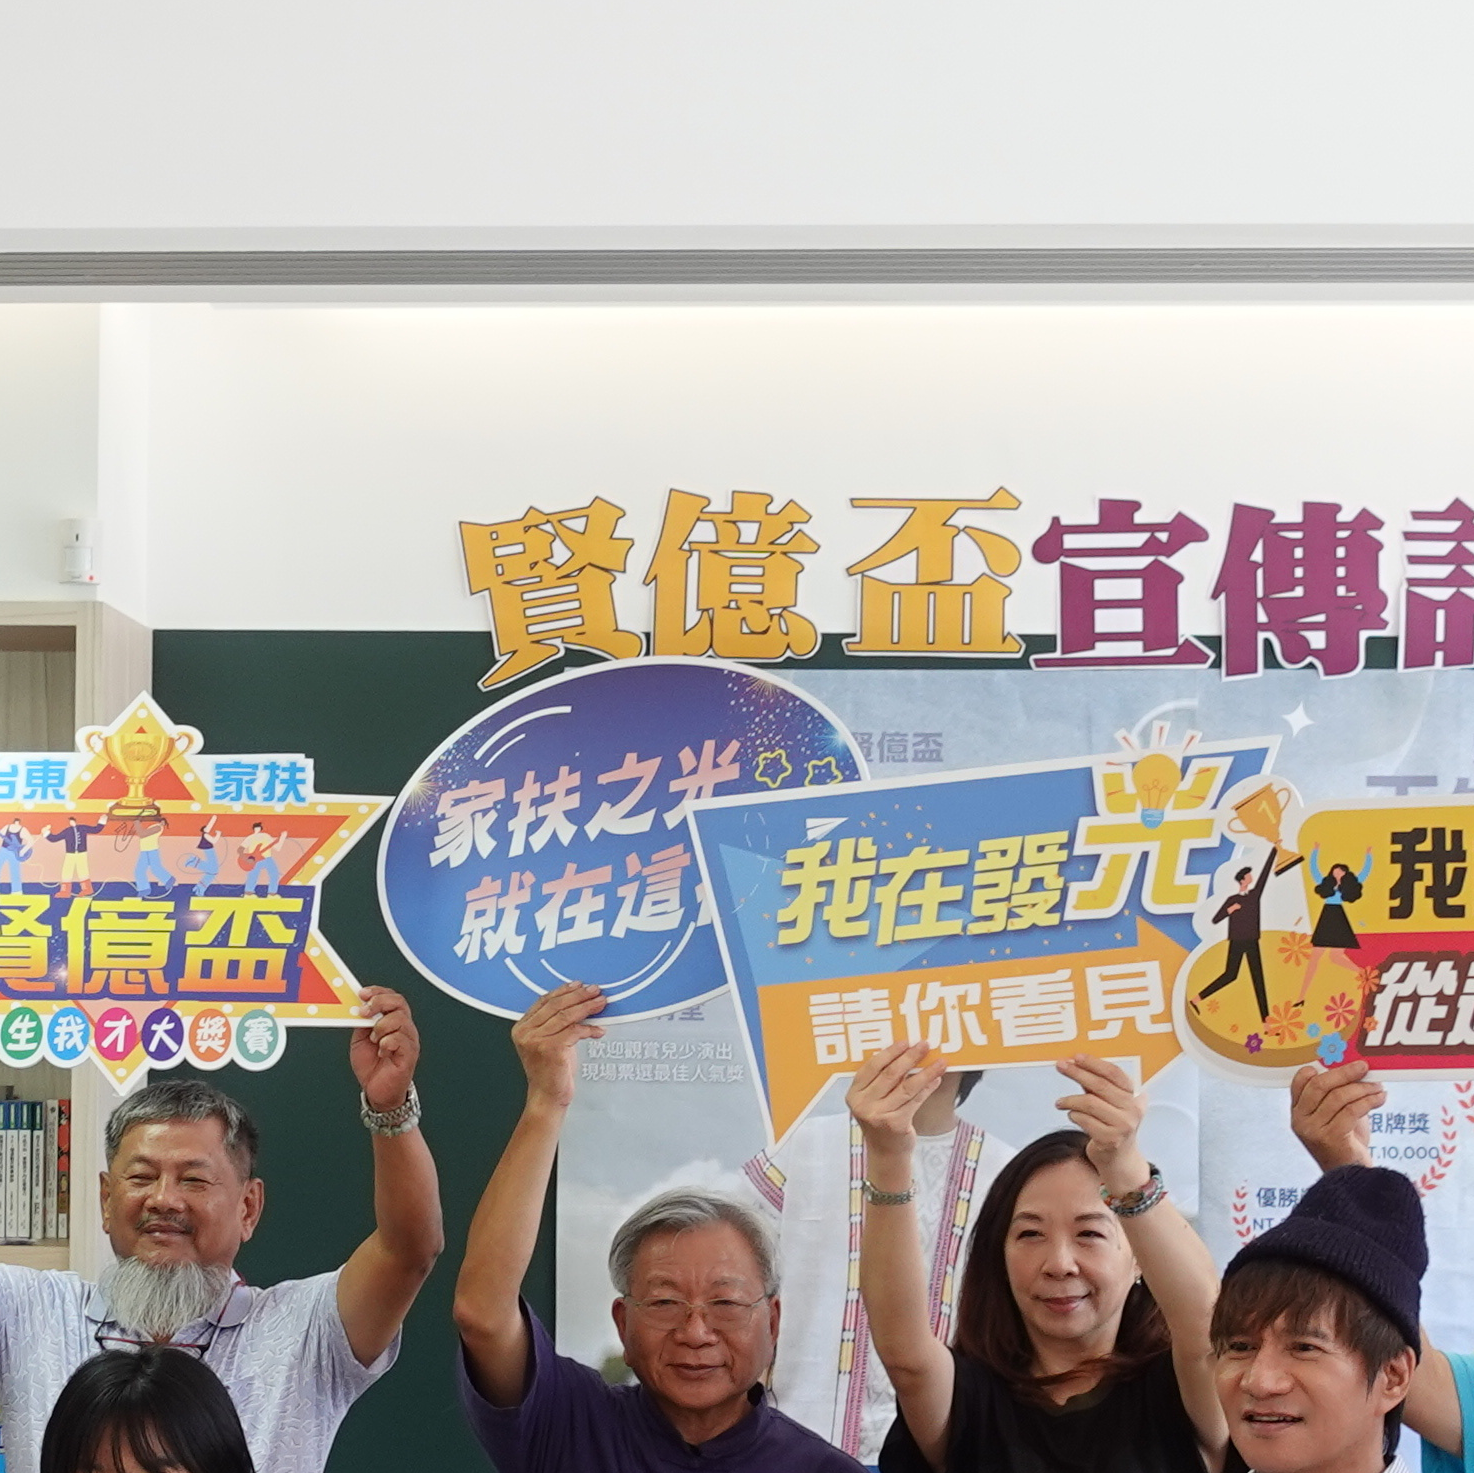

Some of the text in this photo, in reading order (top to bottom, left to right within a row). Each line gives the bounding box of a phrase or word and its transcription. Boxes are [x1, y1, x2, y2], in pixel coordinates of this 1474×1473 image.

[213, 761, 307, 803] 家扶
[777, 754, 1227, 947] 我在發光
[809, 959, 1172, 1064] 請你看見
[588, 1041, 733, 1060] 歡迎觀賞兒少演出
[582, 1063, 744, 1082] 現場票選最佳人氣獎
[1368, 1147, 1440, 1160] T.10,000
